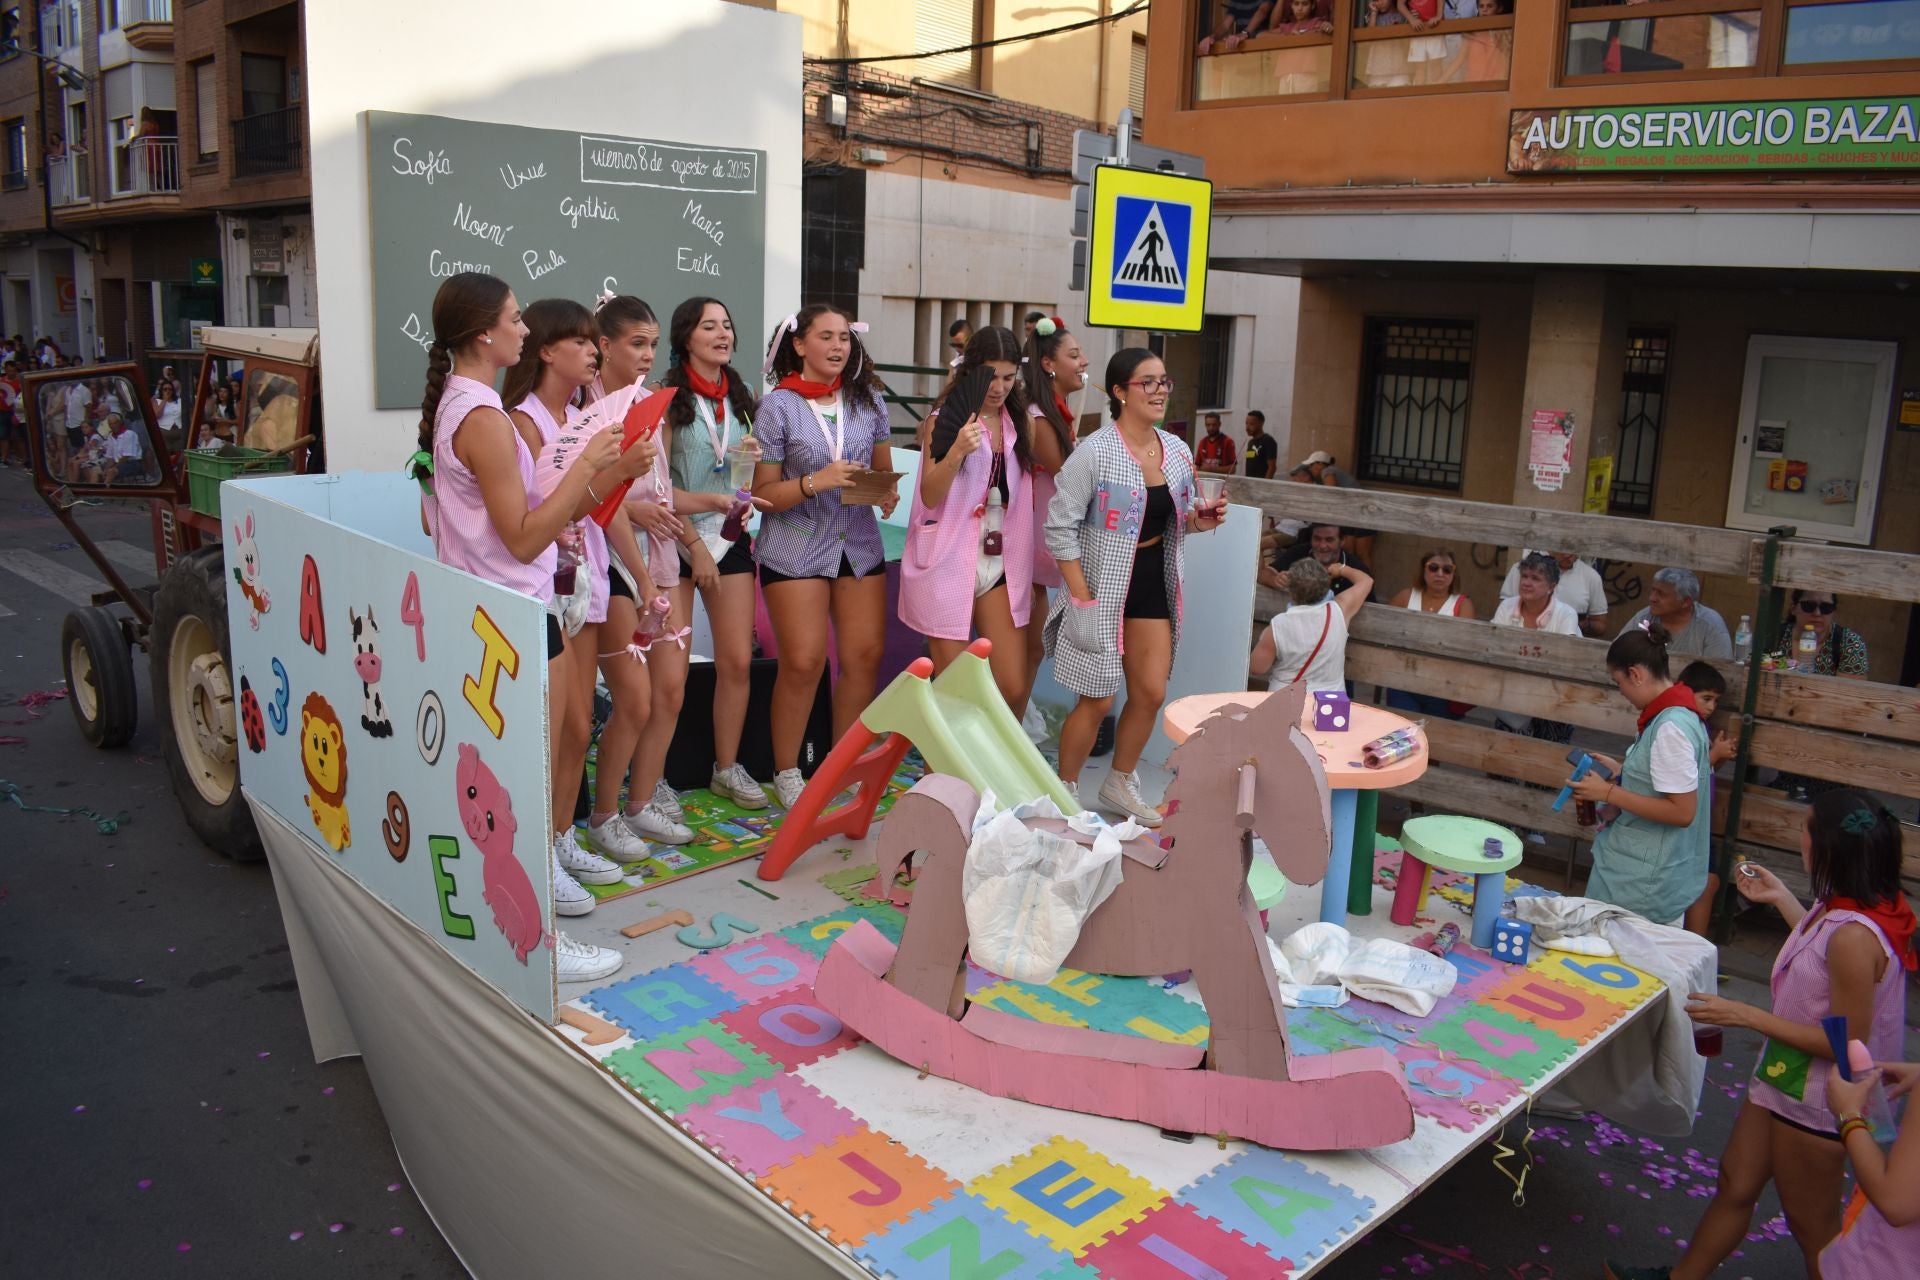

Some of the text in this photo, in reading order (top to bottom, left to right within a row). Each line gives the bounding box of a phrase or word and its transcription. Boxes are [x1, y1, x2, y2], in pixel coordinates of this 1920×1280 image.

[1522, 104, 1920, 151] AUTOSERVICIO BAZA
[392, 137, 453, 185] Sofía
[500, 162, 547, 190] Uxue
[591, 145, 751, 184] viernes 8 de agosto de 2025
[1817, 152, 1877, 164] CHUCHES
[1880, 151, 1889, 163] Y
[1890, 151, 1920, 163] MUC
[453, 202, 514, 247] Noemí
[560, 196, 620, 229] Cynthia
[682, 199, 726, 247] María
[429, 249, 491, 277] Carmen
[522, 249, 567, 281] Paula
[299, 554, 326, 654] A
[401, 570, 426, 662] 4
[268, 656, 290, 736] 3
[382, 791, 410, 863] 9
[428, 834, 475, 941] E
[722, 944, 799, 987] 5
[621, 980, 712, 1022] R
[1506, 982, 1585, 1021] U
[713, 1088, 805, 1142] Y
[838, 1151, 902, 1206] J
[1009, 1159, 1126, 1228] E
[1229, 1174, 1338, 1239] A
